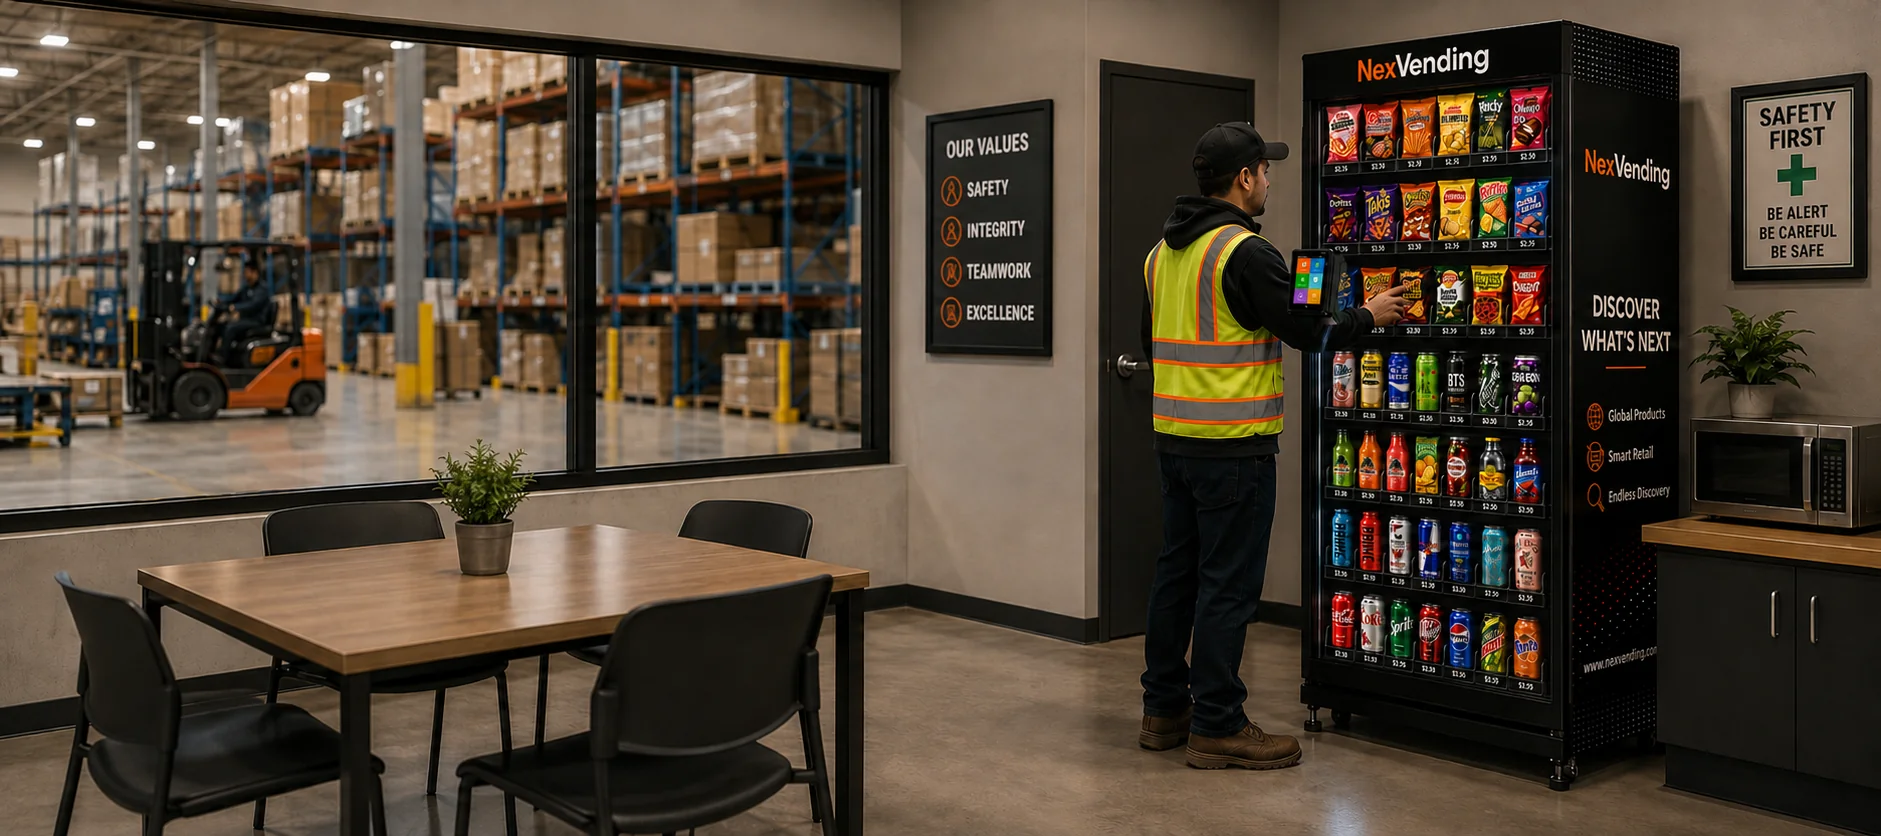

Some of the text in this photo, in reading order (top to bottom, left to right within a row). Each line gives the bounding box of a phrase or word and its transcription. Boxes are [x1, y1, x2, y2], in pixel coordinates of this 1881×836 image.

[1357, 46, 1489, 83] NexVending
[1760, 101, 1836, 127] SAFETY
[946, 132, 1029, 159] OUR VALUES
[1770, 126, 1825, 150] FIRST
[1585, 148, 1670, 190] NexVending
[967, 179, 1009, 198] SAFETY
[1767, 204, 1829, 221] BE ALERT
[967, 220, 1025, 239] INTEGRITY
[1759, 223, 1837, 240] BE CAREFUL
[1771, 243, 1824, 259] BE SAFE
[966, 262, 1032, 280] TEAMWORK
[966, 304, 1035, 321] EXCELLENCE
[1593, 294, 1660, 320] DISCOVER
[1581, 329, 1671, 352] WHAT'S NEXT
[1448, 373, 1465, 387] BTS
[1608, 407, 1666, 422] Global Products
[1608, 445, 1654, 463] Smart Retail
[1608, 486, 1671, 503] Endless Discovery
